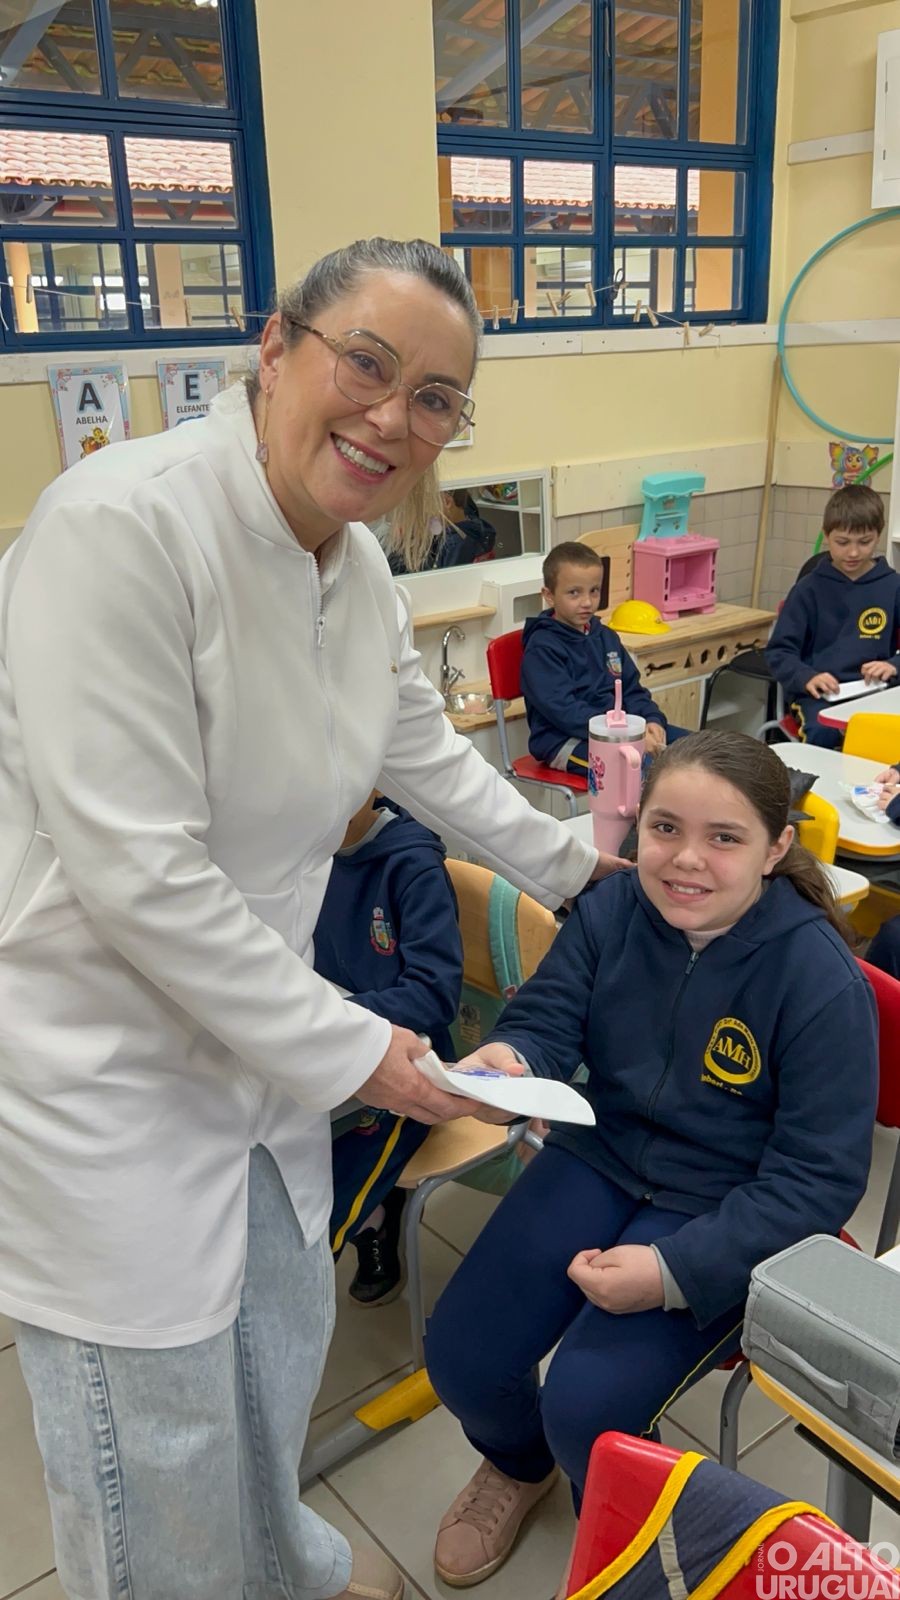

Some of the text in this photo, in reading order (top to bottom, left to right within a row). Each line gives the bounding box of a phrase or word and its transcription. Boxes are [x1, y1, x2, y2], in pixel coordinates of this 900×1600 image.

[79, 382, 102, 412] A
[185, 374, 200, 400] E
[76, 415, 108, 425] ABELHA
[176, 403, 210, 414] ELEFANTE
[712, 1036, 752, 1070] AMH
